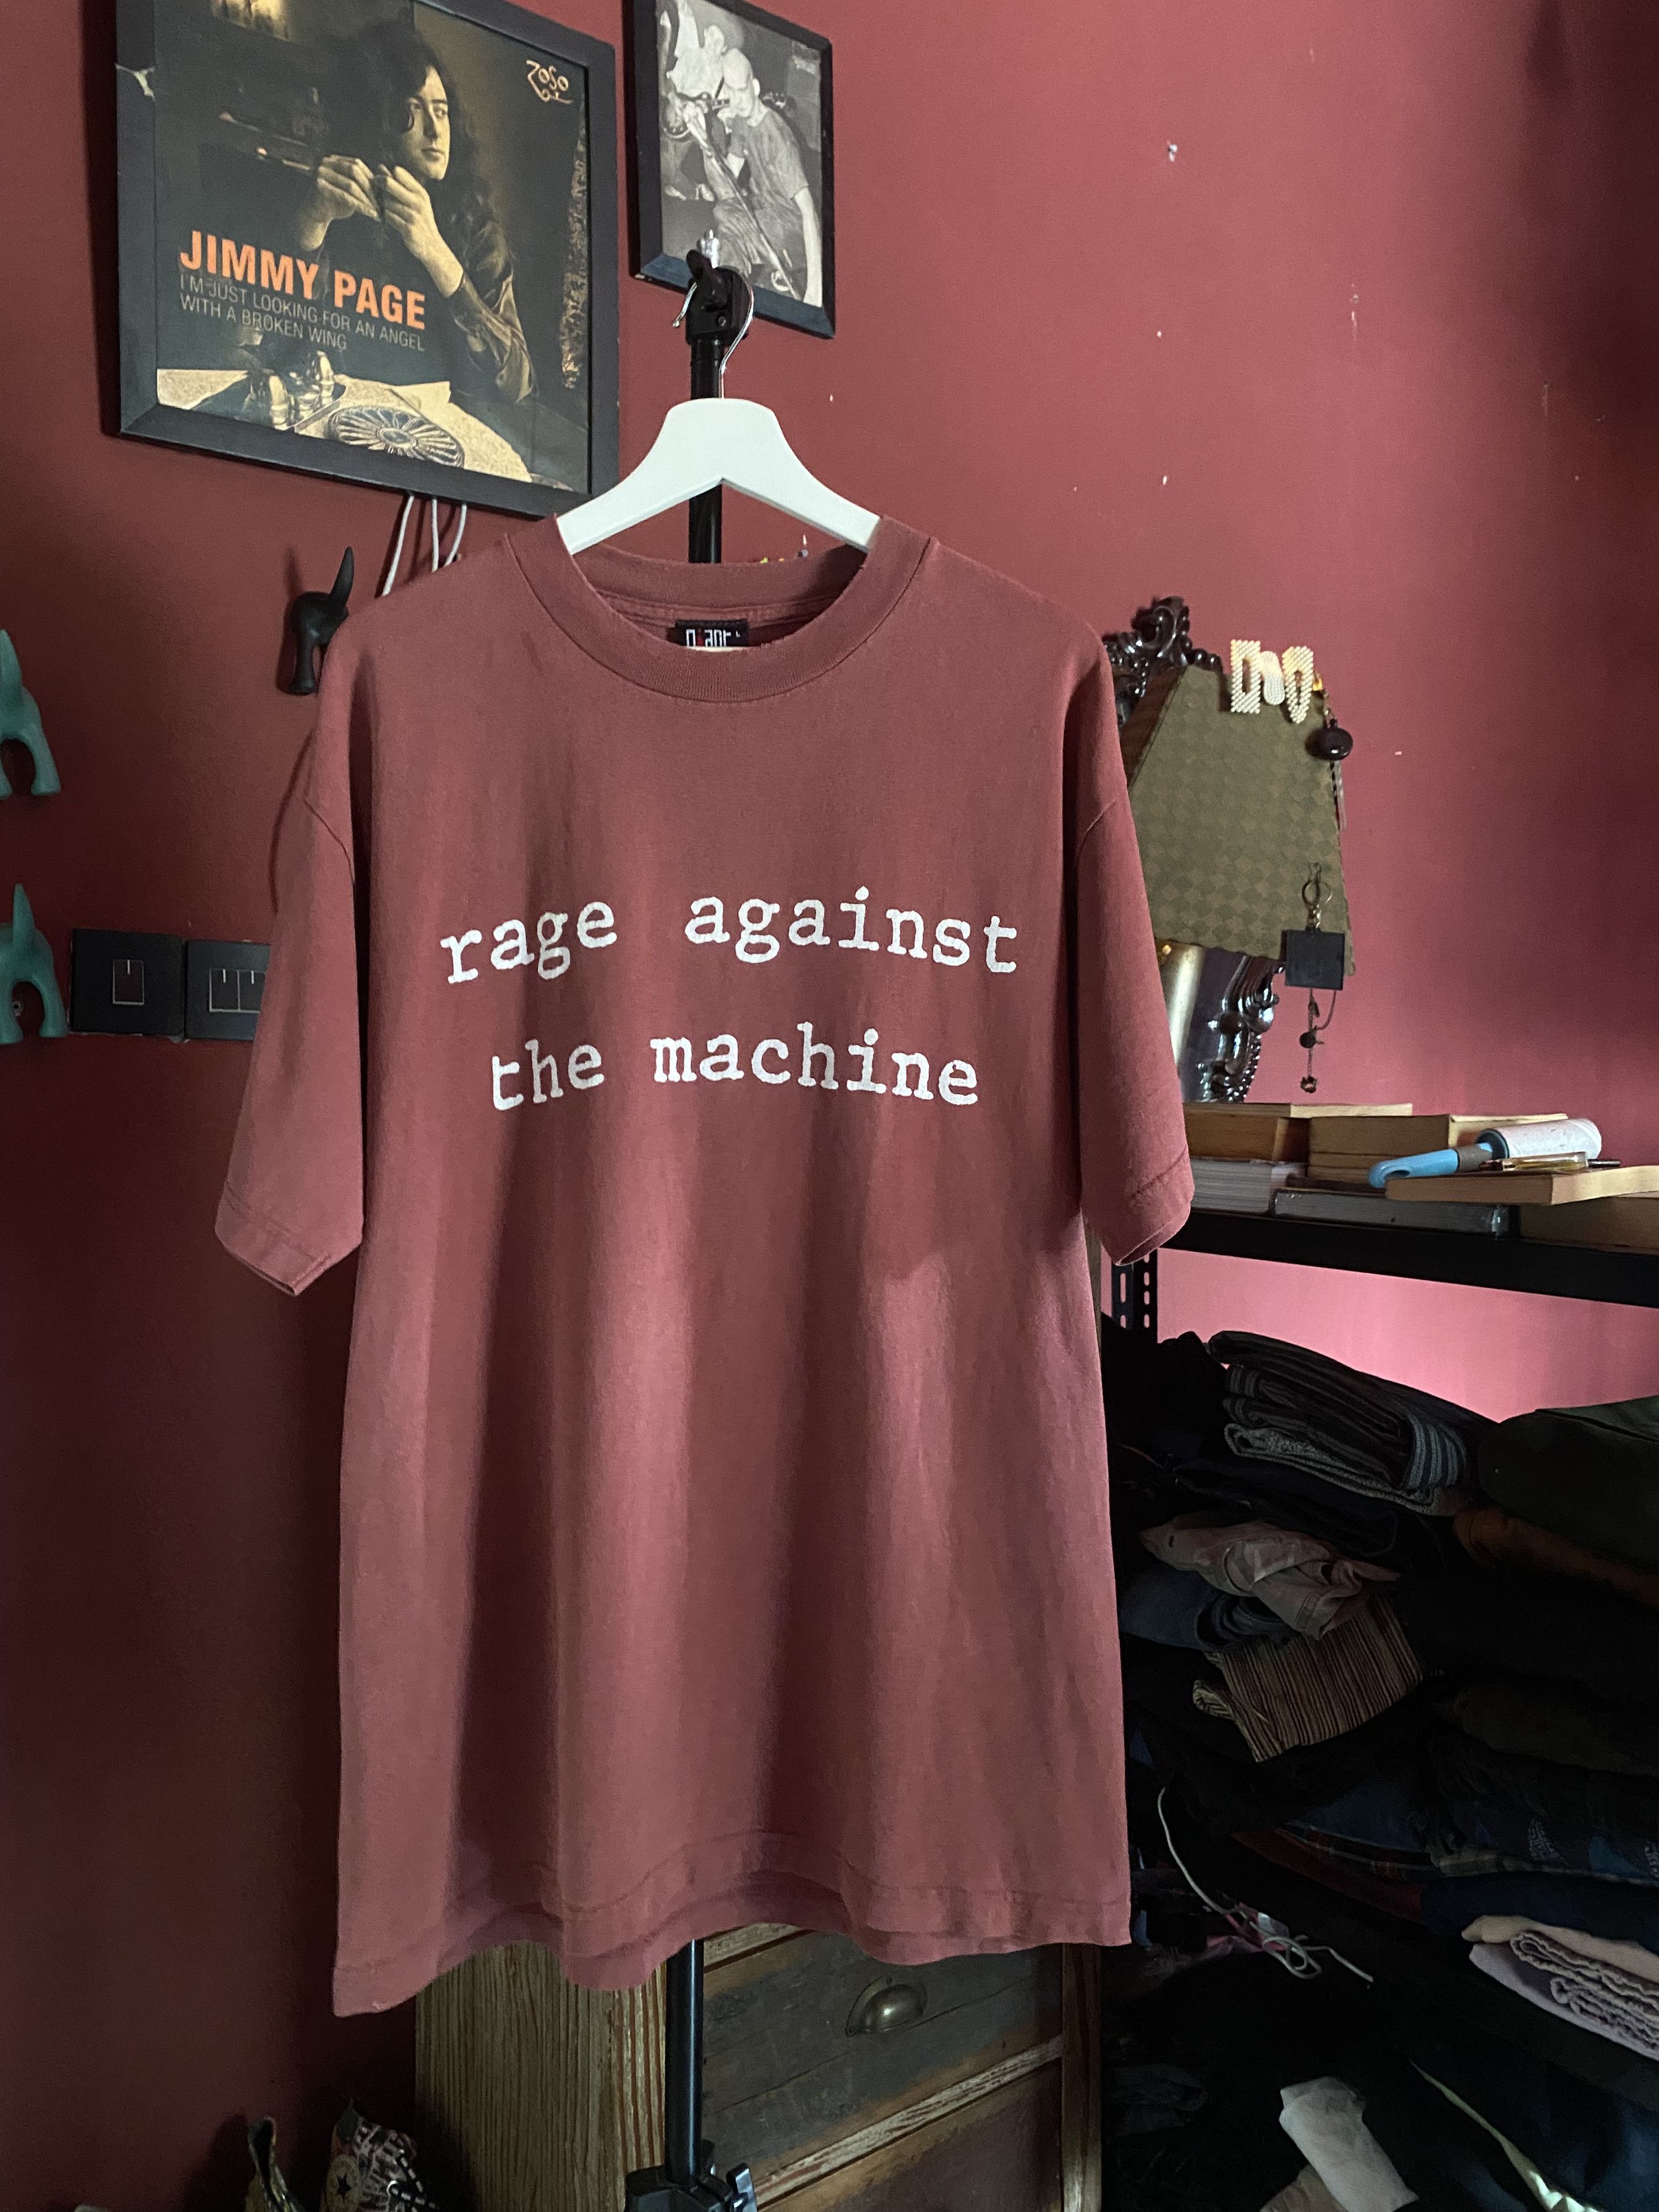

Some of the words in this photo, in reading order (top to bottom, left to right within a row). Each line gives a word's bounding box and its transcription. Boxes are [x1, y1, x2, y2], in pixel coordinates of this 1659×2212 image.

[179, 230, 319, 300] JIMMY
[334, 270, 425, 330] PAGE
[179, 293, 221, 319] WITH
[226, 308, 237, 322] A
[241, 310, 303, 339] BROKEN
[307, 326, 348, 351] WING
[180, 274, 204, 293] I'M
[210, 279, 248, 304] JUST
[253, 292, 318, 324] LOOKING
[322, 309, 350, 331] FOR
[355, 319, 375, 339] AN
[379, 326, 425, 352] ANGEL
[439, 901, 617, 985] rage
[684, 885, 1018, 974] against
[491, 1038, 605, 1112] the
[648, 1021, 979, 1107] machine
